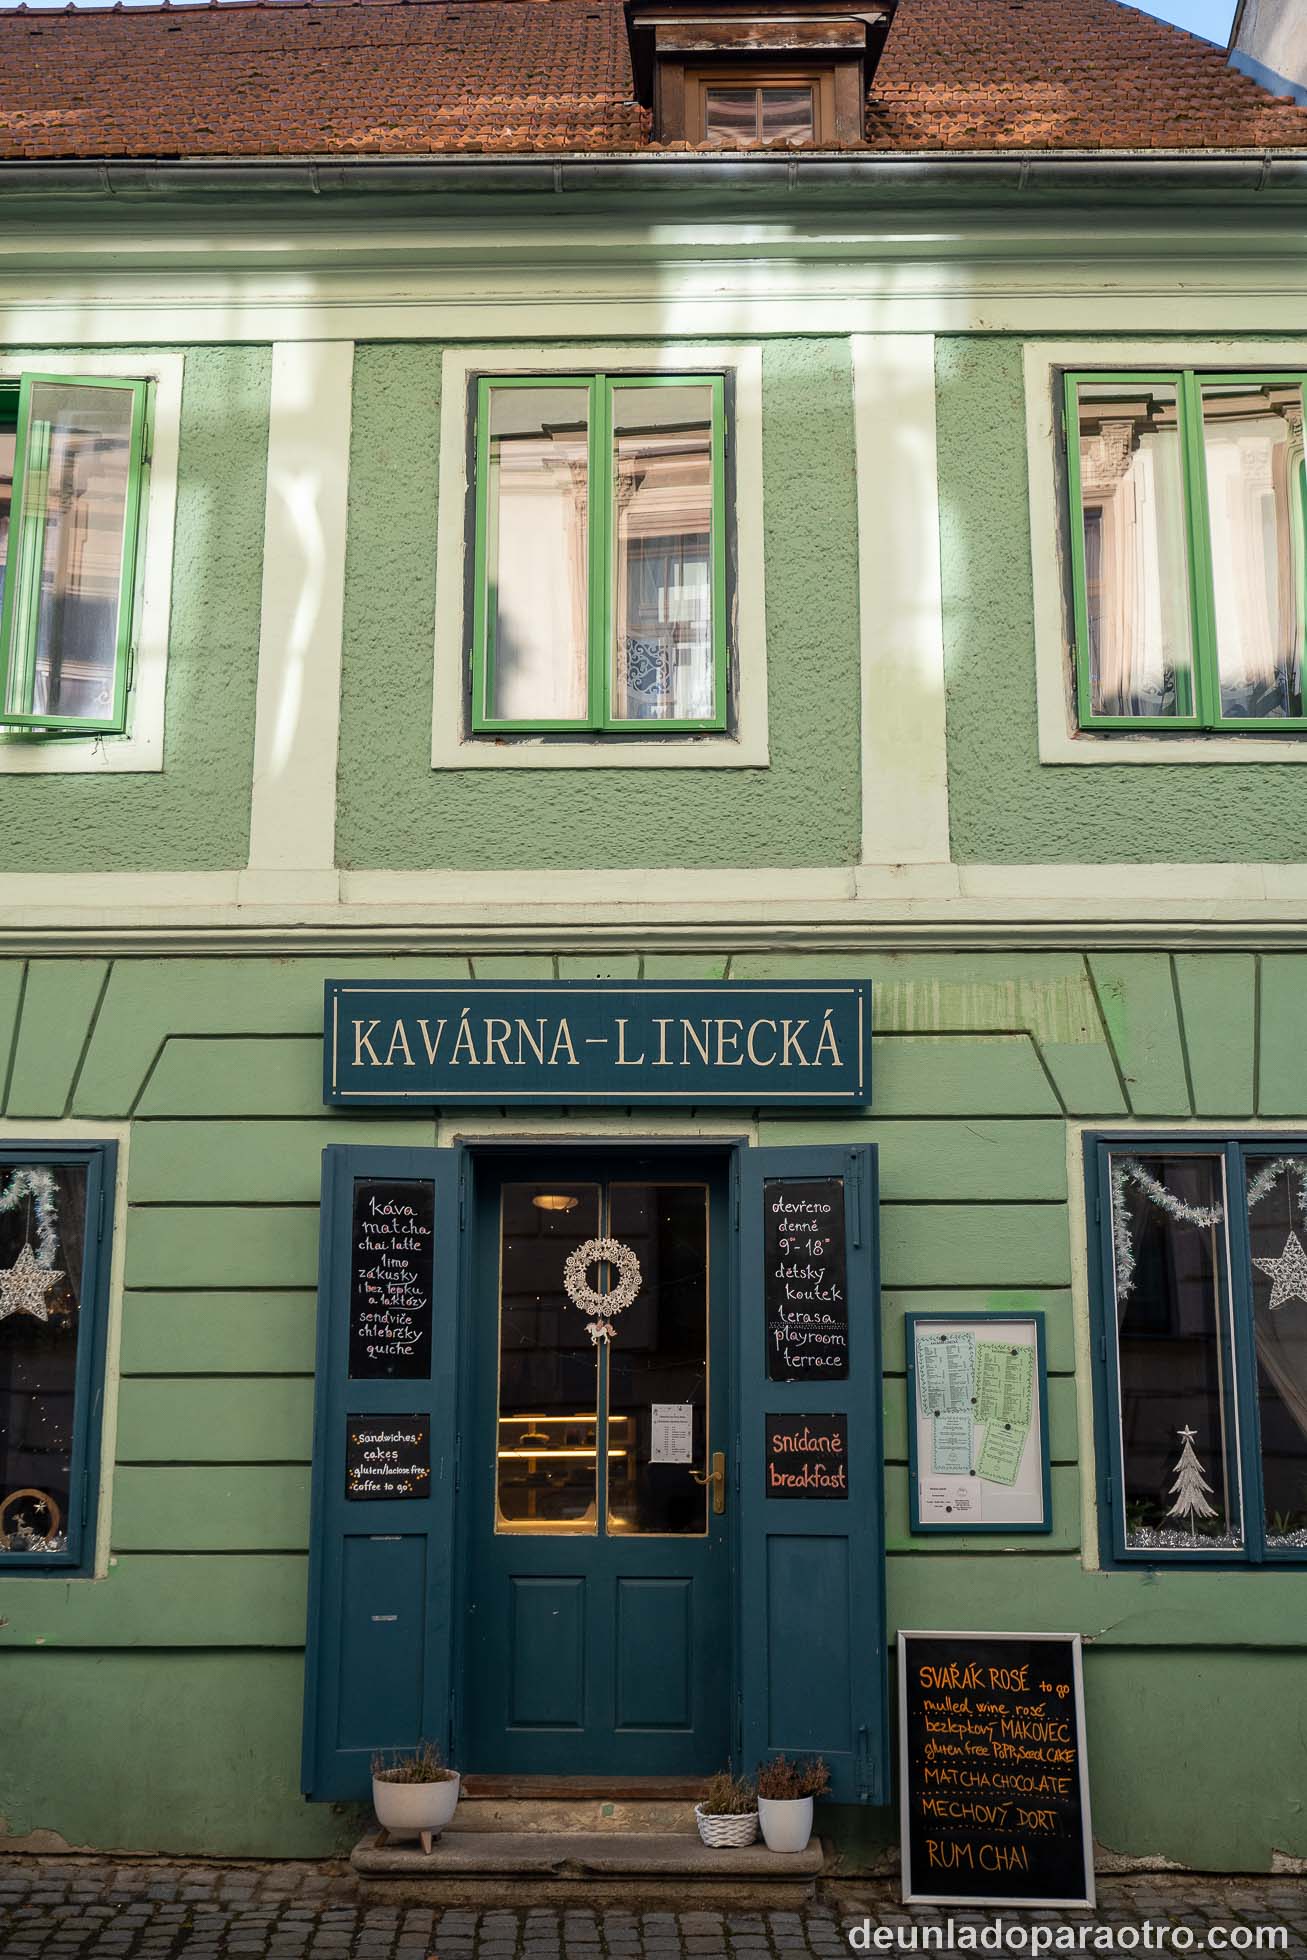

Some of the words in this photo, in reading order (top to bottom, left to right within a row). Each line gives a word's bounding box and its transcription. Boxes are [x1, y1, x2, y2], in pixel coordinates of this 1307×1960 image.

[369, 1195, 418, 1216] káva
[772, 1195, 831, 1213] otevřeno
[361, 1218, 431, 1235] matcha
[778, 1217, 819, 1232] denně
[358, 1236, 389, 1251] chai
[391, 1237, 422, 1251] latte
[381, 1253, 409, 1267] limo
[358, 1265, 418, 1286] zákusky
[775, 1262, 826, 1284] dětský
[364, 1281, 383, 1294] bez
[387, 1282, 423, 1299] lepku
[785, 1283, 843, 1301] koutek
[368, 1297, 378, 1305] a
[380, 1293, 427, 1311] laktózy
[359, 1310, 413, 1325] sendviče
[358, 1323, 423, 1345] chlebíčky
[774, 1325, 846, 1351] playroom
[366, 1341, 415, 1359] quiche
[784, 1347, 842, 1367] terrace
[772, 1426, 843, 1453] snídaně
[364, 1447, 398, 1459] cakes
[411, 1464, 425, 1474] free
[769, 1462, 846, 1489] breakfast
[353, 1480, 381, 1491] coffee
[384, 1482, 394, 1491] to
[397, 1484, 408, 1494] go
[919, 1662, 986, 1690] SVAŘÁK
[989, 1664, 1031, 1692] ROSÉ
[1039, 1680, 1052, 1693] to
[1056, 1684, 1070, 1699] go
[924, 1696, 973, 1713] mulled
[976, 1701, 1009, 1714] wine
[1015, 1702, 1047, 1717] rosé
[924, 1714, 998, 1743] bezlepkový
[1001, 1718, 1070, 1743] MAKOVEC
[924, 1737, 963, 1760] gluten
[965, 1741, 991, 1757] free
[1046, 1747, 1077, 1763] CAKE
[992, 1773, 1073, 1794] CHOCOLATE
[922, 1798, 1014, 1826] MECHOVÝ
[1016, 1807, 1058, 1831] DORT
[926, 1840, 975, 1870] RUM
[979, 1844, 1030, 1872] CHAI
